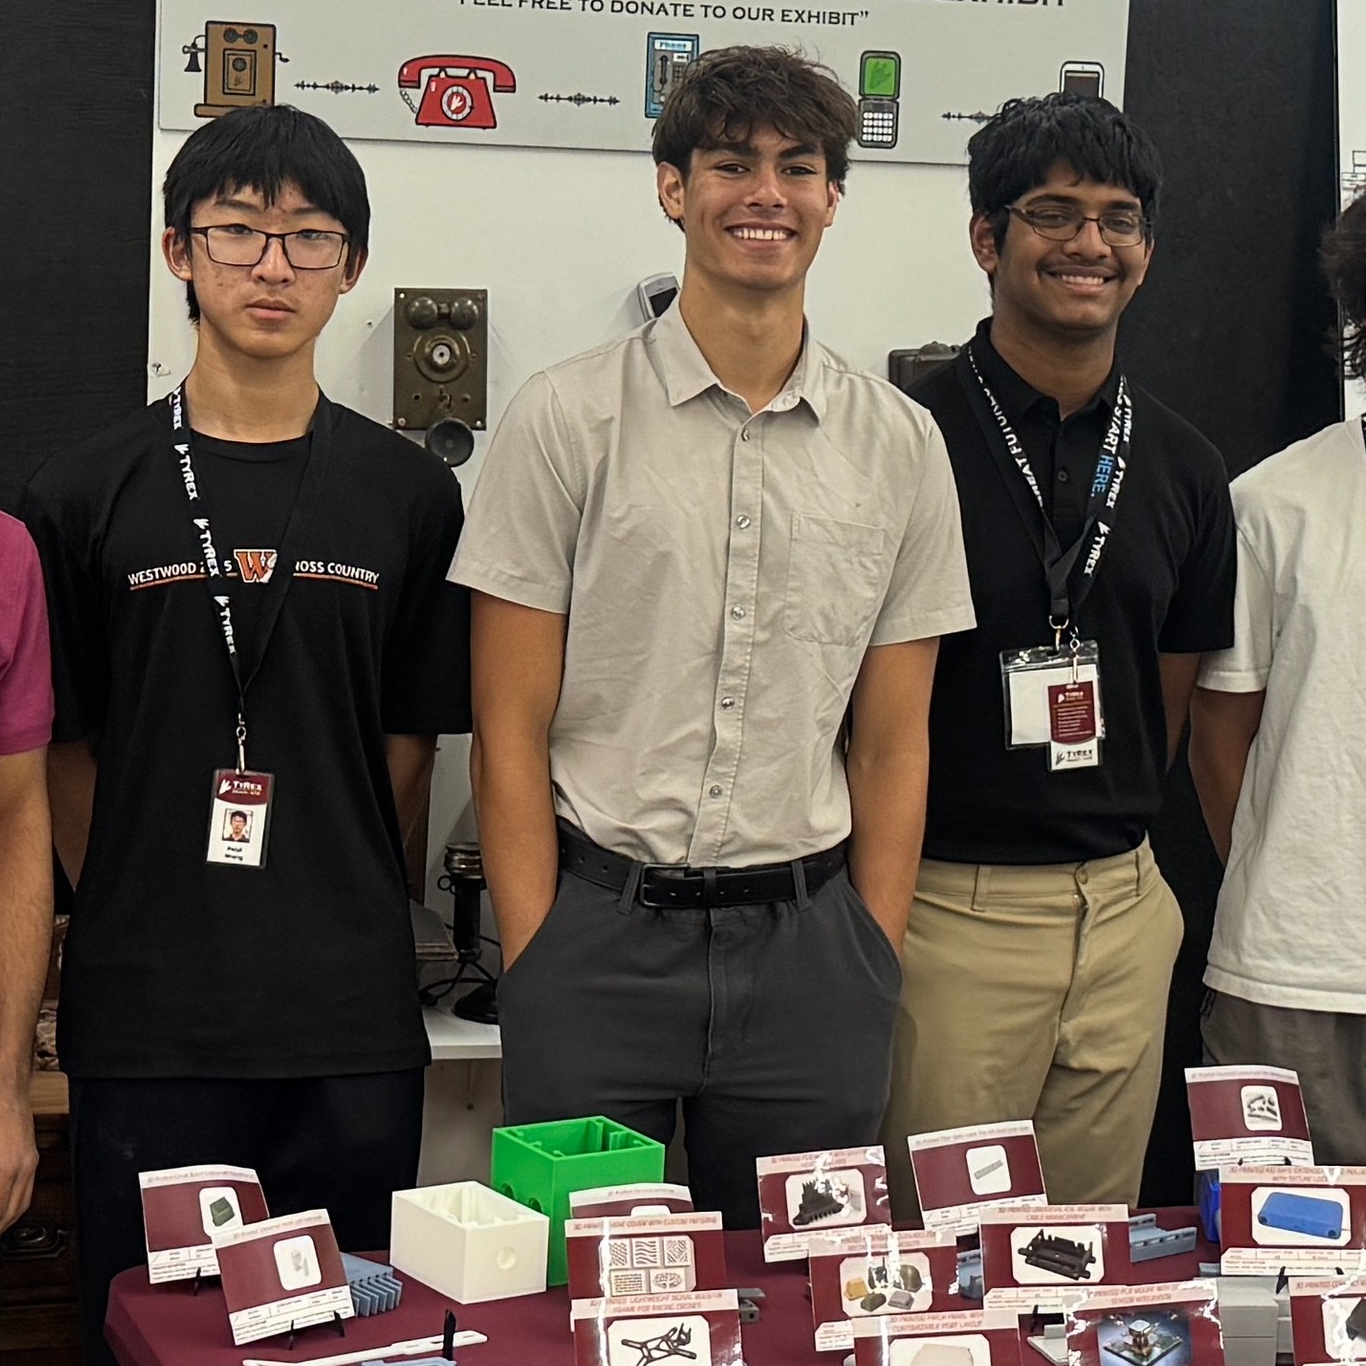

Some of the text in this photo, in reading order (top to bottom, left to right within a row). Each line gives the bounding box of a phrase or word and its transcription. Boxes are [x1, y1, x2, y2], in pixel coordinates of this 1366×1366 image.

[611, 0, 695, 19] DONATE
[700, 3, 727, 20] TO
[732, 5, 775, 23] OUR
[179, 455, 201, 500] TYREX
[1091, 455, 1114, 497] HERE.
[198, 529, 220, 578] TYREX
[327, 562, 380, 584] COUNTRY
[1084, 536, 1105, 577] TYREX
[127, 563, 197, 586] WESTWOOD
[219, 606, 236, 654] TYREX
